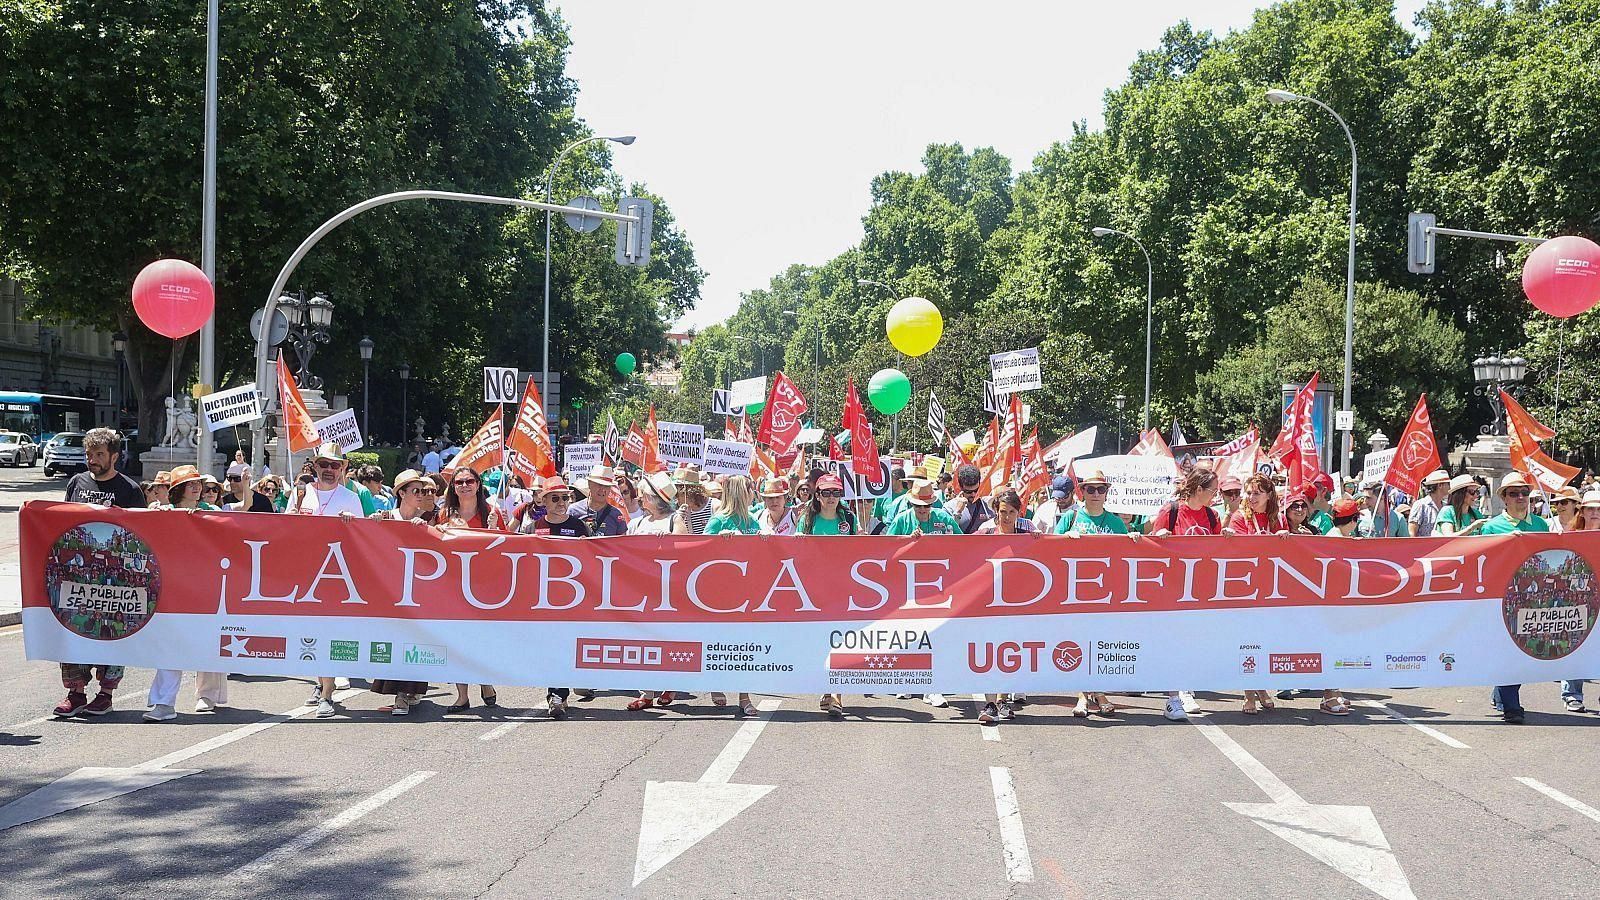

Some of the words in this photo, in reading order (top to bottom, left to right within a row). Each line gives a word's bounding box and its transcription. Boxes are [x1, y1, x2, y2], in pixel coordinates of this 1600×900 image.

[1558, 258, 1590, 268] CCOO
[161, 284, 190, 294] CCOO
[486, 369, 516, 401] NO
[204, 391, 255, 412] DICTADURA
[671, 430, 702, 445] DES-EDUCAR
[659, 443, 672, 457] PARA
[672, 445, 702, 460] DOMINAR.
[707, 444, 723, 456] Piden
[570, 464, 587, 472] Escuela
[704, 459, 717, 468] para
[78, 489, 117, 502] PALESTINA
[1125, 487, 1172, 496] PRESUPUESTO
[1122, 498, 1165, 506] CLIMATIZACI
[217, 539, 368, 614] ¡LA
[394, 536, 821, 614] PÚBLICA
[847, 558, 953, 611] SE
[985, 554, 1486, 608] DEFIENDE!
[71, 585, 86, 598] LA
[90, 585, 138, 601] PÚBLICA
[66, 597, 83, 607] SE
[86, 599, 142, 612] DEFIENDE
[1525, 611, 1537, 622] LA
[1522, 622, 1534, 632] SE
[1536, 619, 1583, 633] DEFIENDE
[829, 630, 933, 650] CONFAPA
[1097, 640, 1140, 650] Servicios
[420, 649, 435, 658] Más
[707, 642, 762, 653] educación
[765, 645, 772, 655] y
[582, 644, 662, 665] CCOO
[706, 652, 754, 662] servicios
[968, 641, 1046, 674] UGT
[1097, 652, 1137, 662] Públicos
[1386, 654, 1426, 663] Podemos
[420, 657, 445, 665] Madrid
[706, 662, 794, 672] socioeducativos
[1097, 664, 1135, 675] Madrid
[1272, 662, 1296, 672] PSOE
[1395, 663, 1421, 671] Madrid
